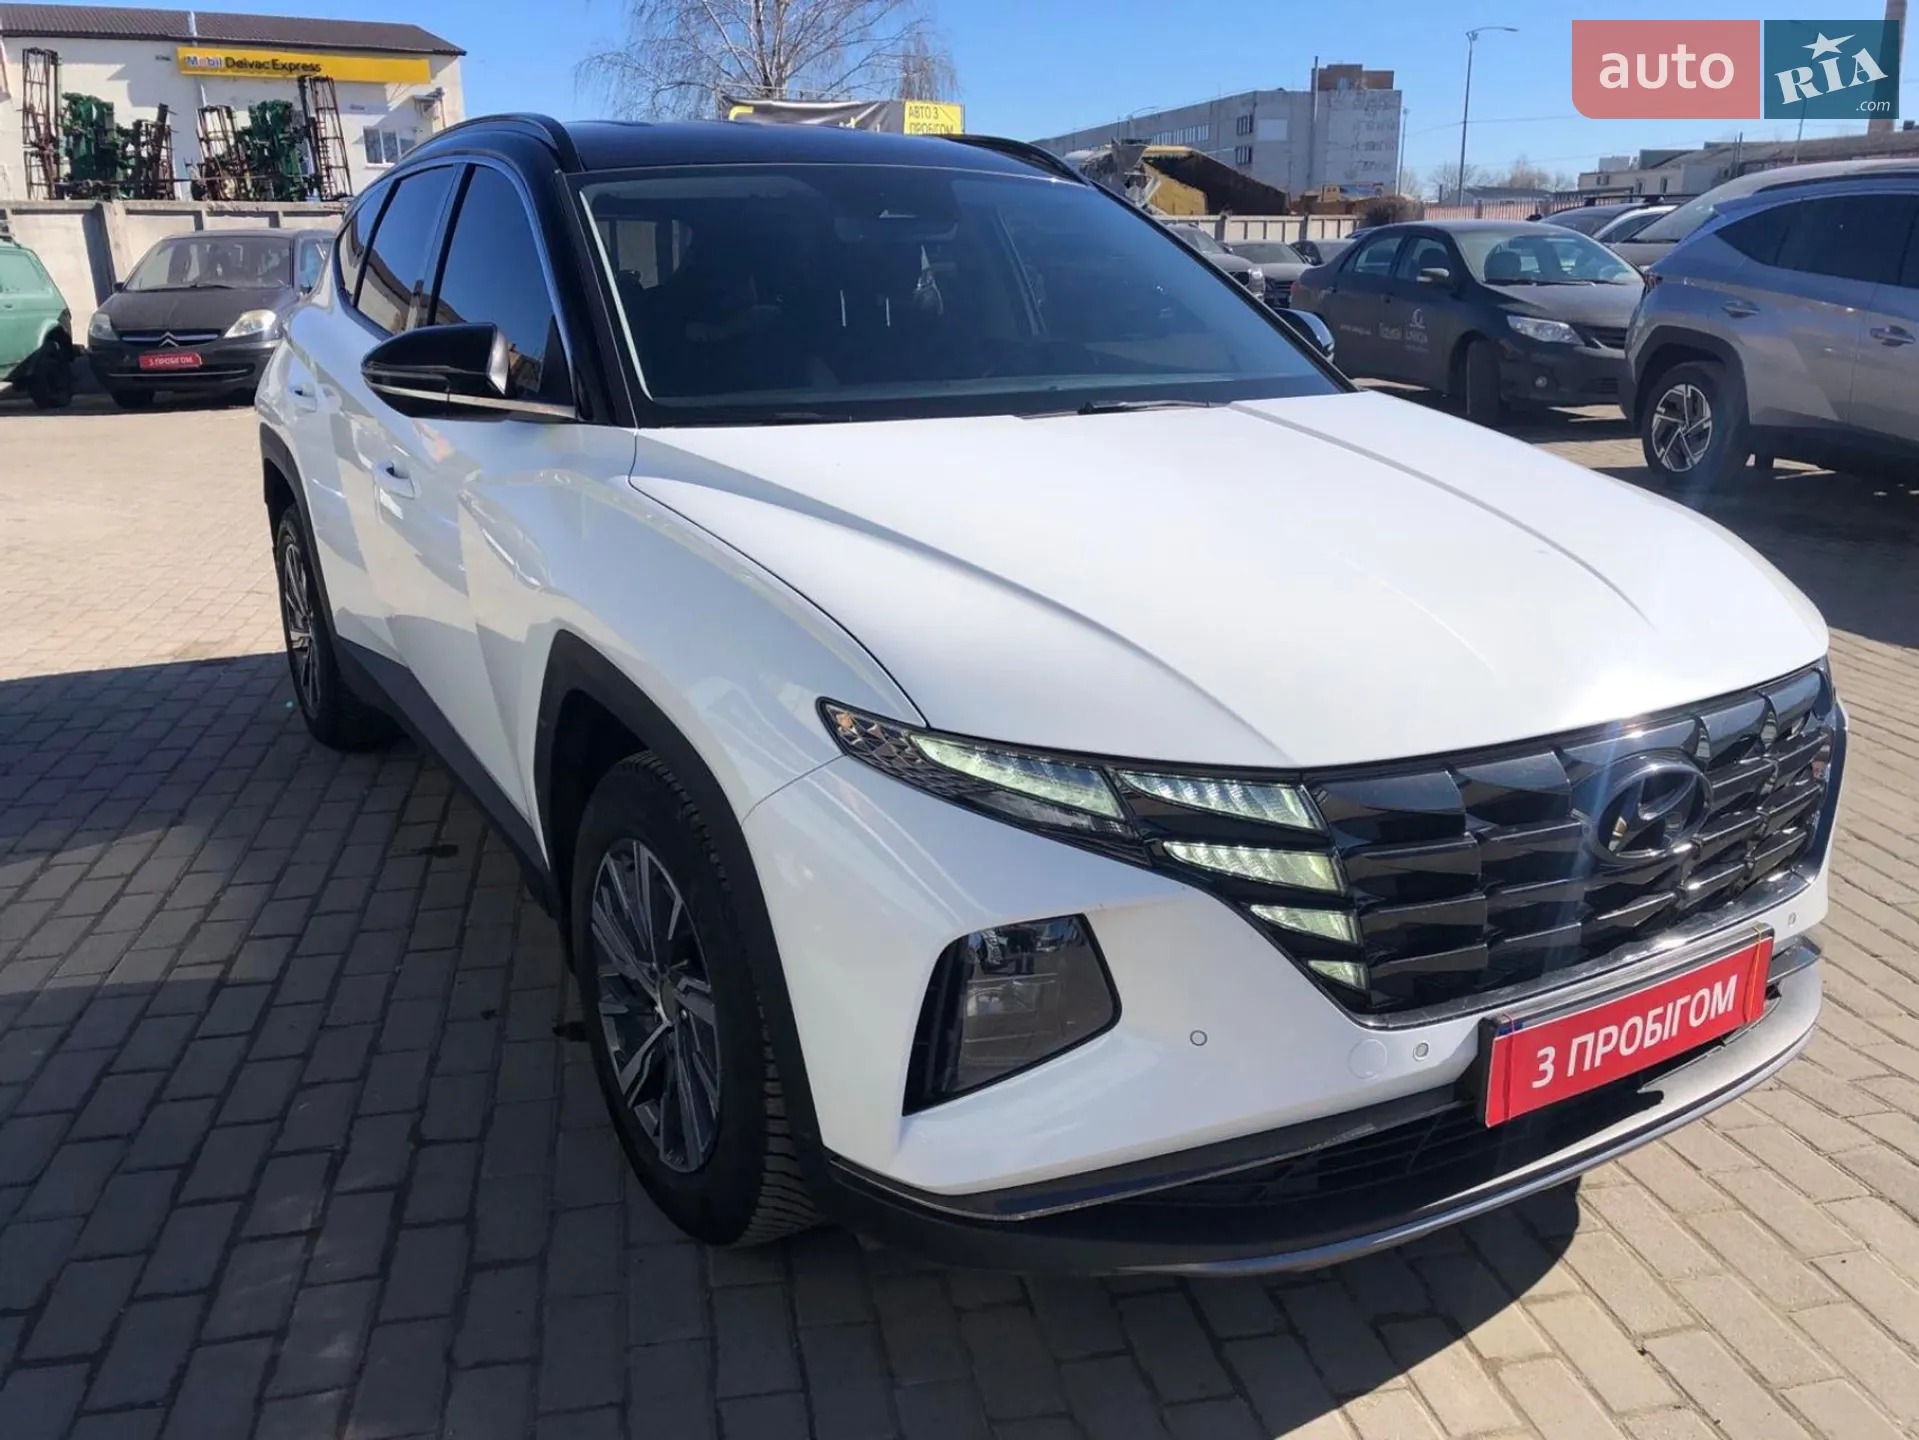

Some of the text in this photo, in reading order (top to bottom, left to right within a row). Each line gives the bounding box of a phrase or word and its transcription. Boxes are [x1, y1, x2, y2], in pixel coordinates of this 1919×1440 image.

[185, 56, 322, 72] Mobil Delvac Express
[909, 105, 932, 119] АВТО
[1532, 974, 1738, 1089] З ПРОБІГОМ
